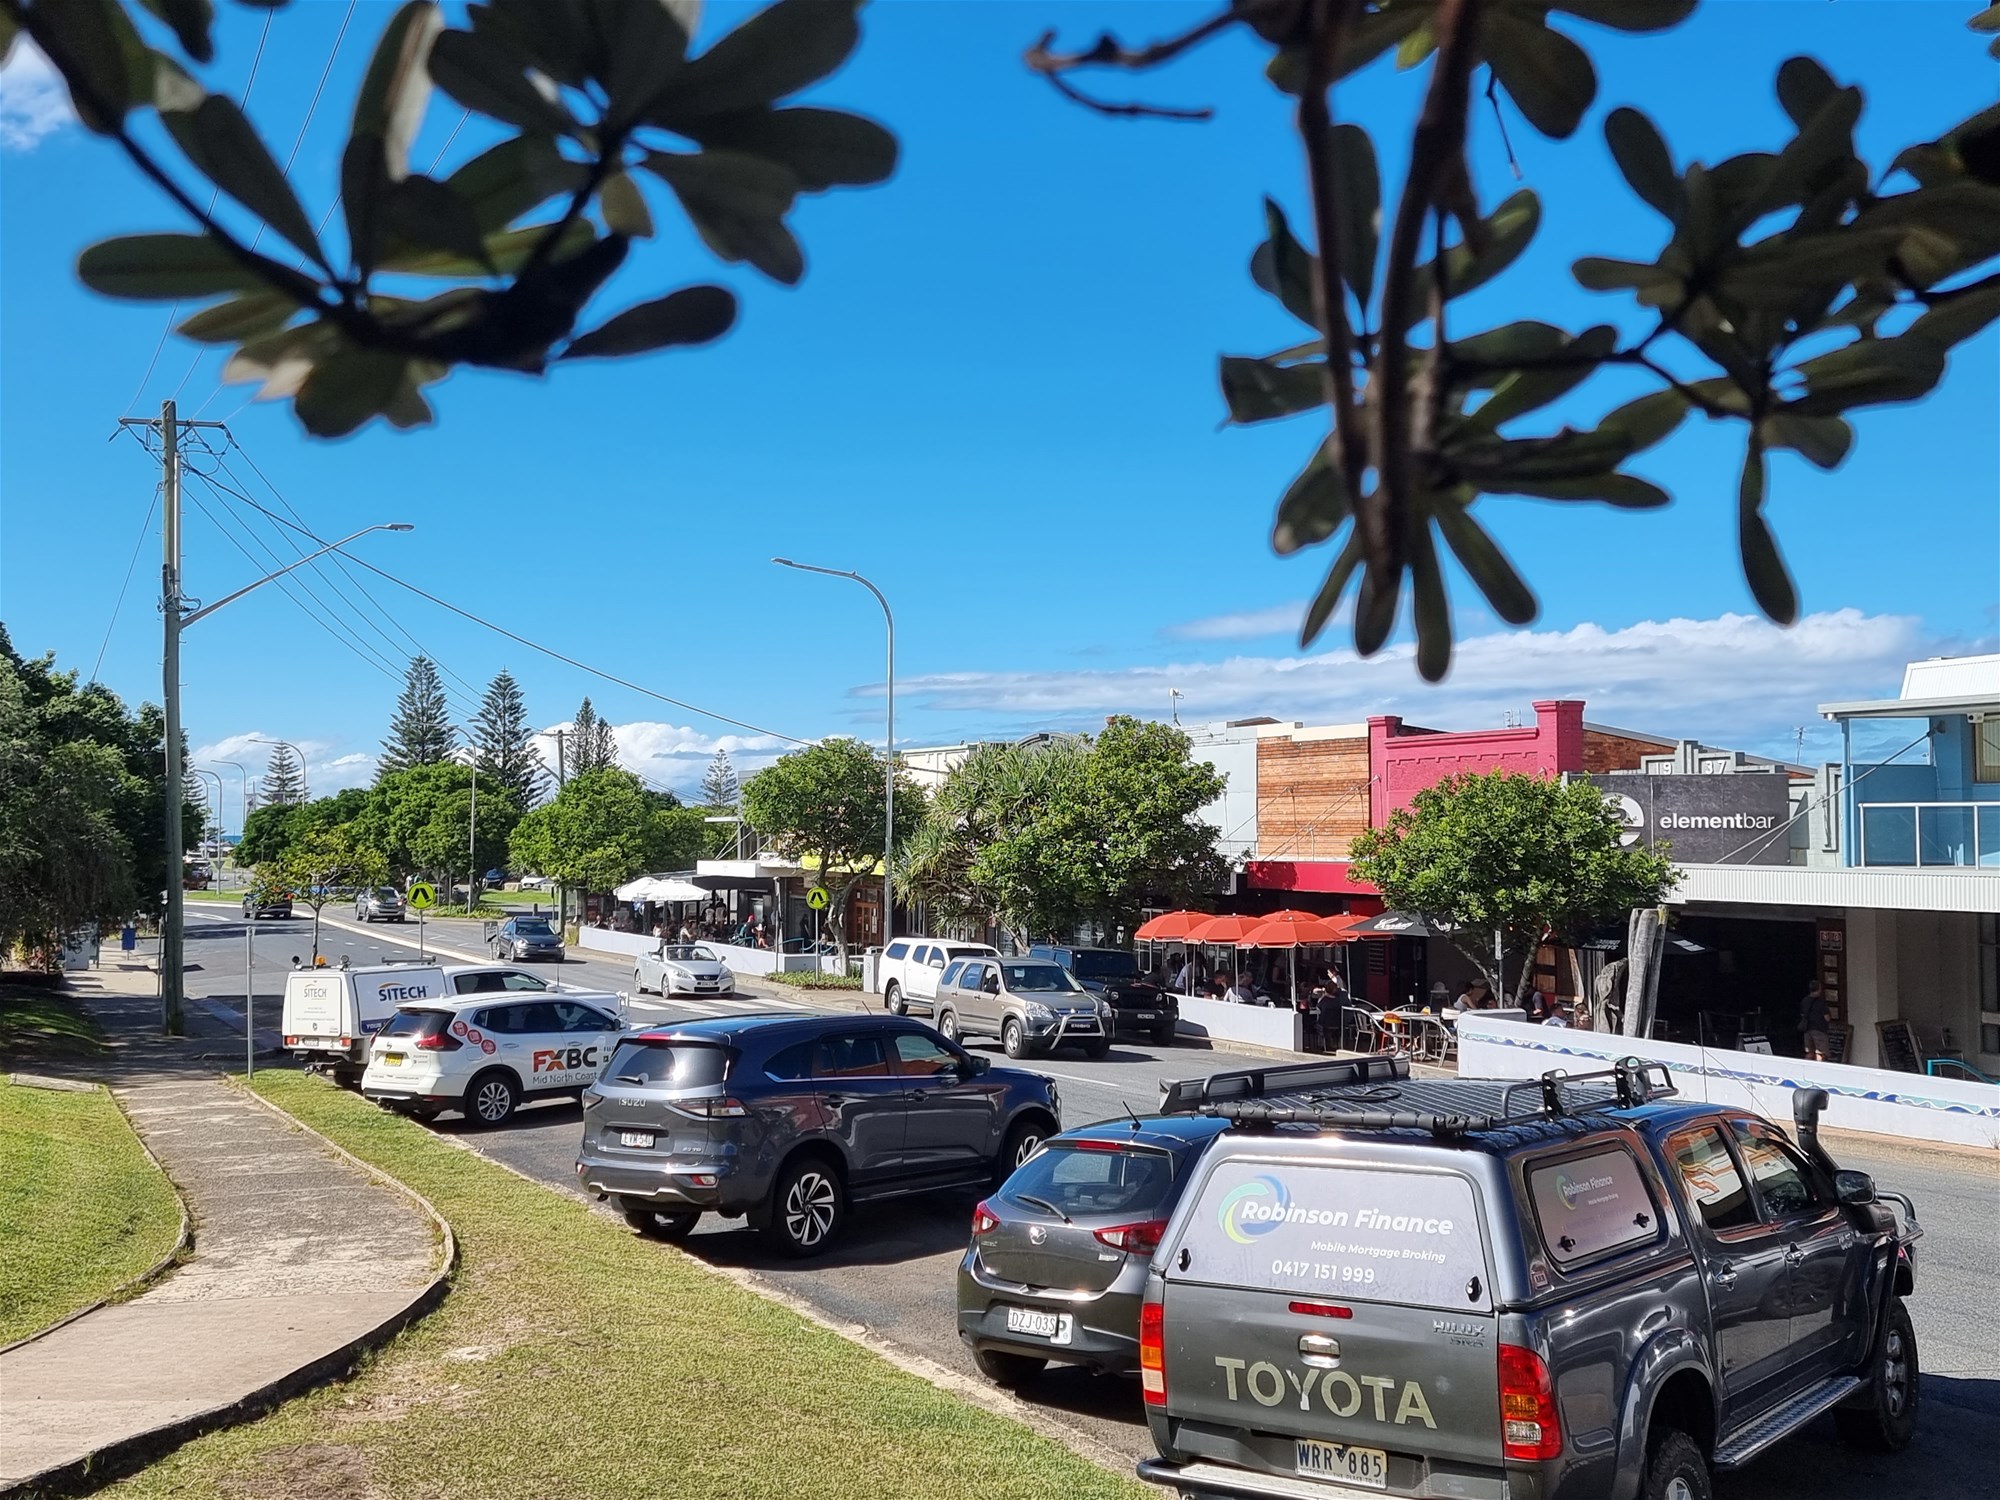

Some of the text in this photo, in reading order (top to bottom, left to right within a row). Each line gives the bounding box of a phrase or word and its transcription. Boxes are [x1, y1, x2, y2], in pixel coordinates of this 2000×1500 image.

[1659, 812, 1775, 829] elementbar
[303, 987, 327, 998] SITECH
[378, 985, 427, 1001] SITECH
[533, 1046, 598, 1073] FXBC
[532, 1071, 598, 1084] Mid North Coast
[618, 1098, 647, 1107] ISUZU
[1241, 1200, 1454, 1236] Robinson Finance
[1310, 1239, 1447, 1265] Mobile Mortgage Broking
[1271, 1259, 1376, 1284] 0417 151 999
[1214, 1355, 1439, 1430] TOYOTA
[1297, 1443, 1383, 1478] WRR 885
